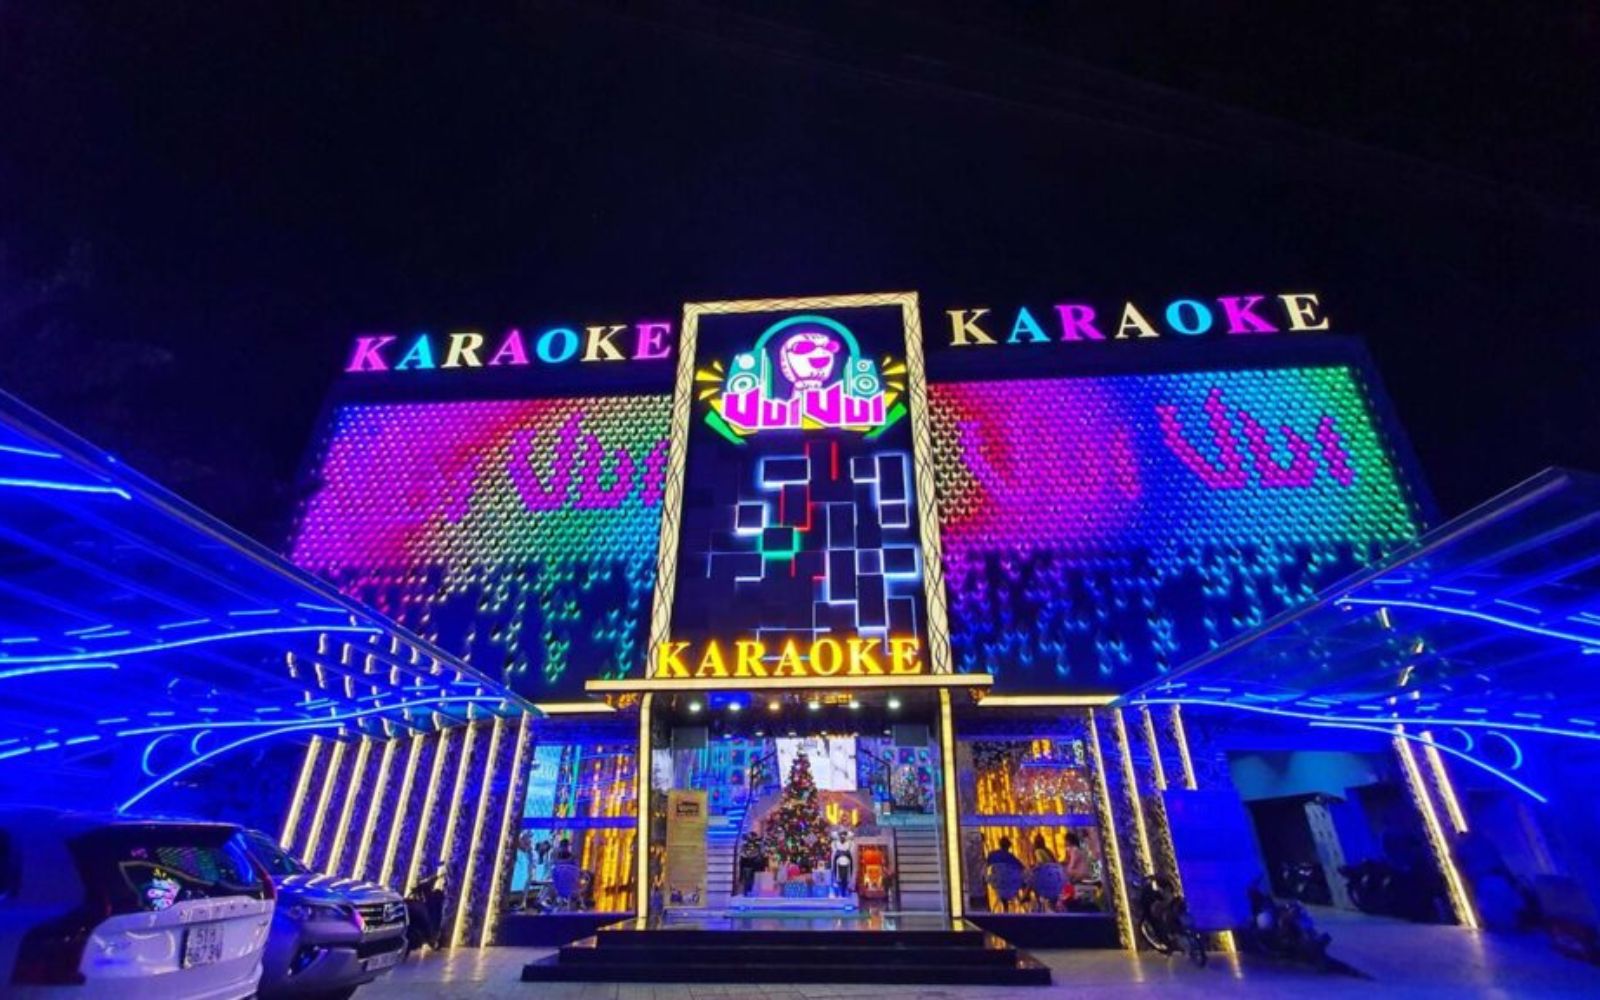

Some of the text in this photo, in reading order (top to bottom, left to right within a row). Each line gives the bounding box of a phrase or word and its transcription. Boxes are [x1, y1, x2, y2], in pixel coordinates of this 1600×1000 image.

[945, 293, 1330, 346] KARAOKE
[345, 322, 671, 372] KARAOKE
[655, 638, 922, 678] KARAOKE
